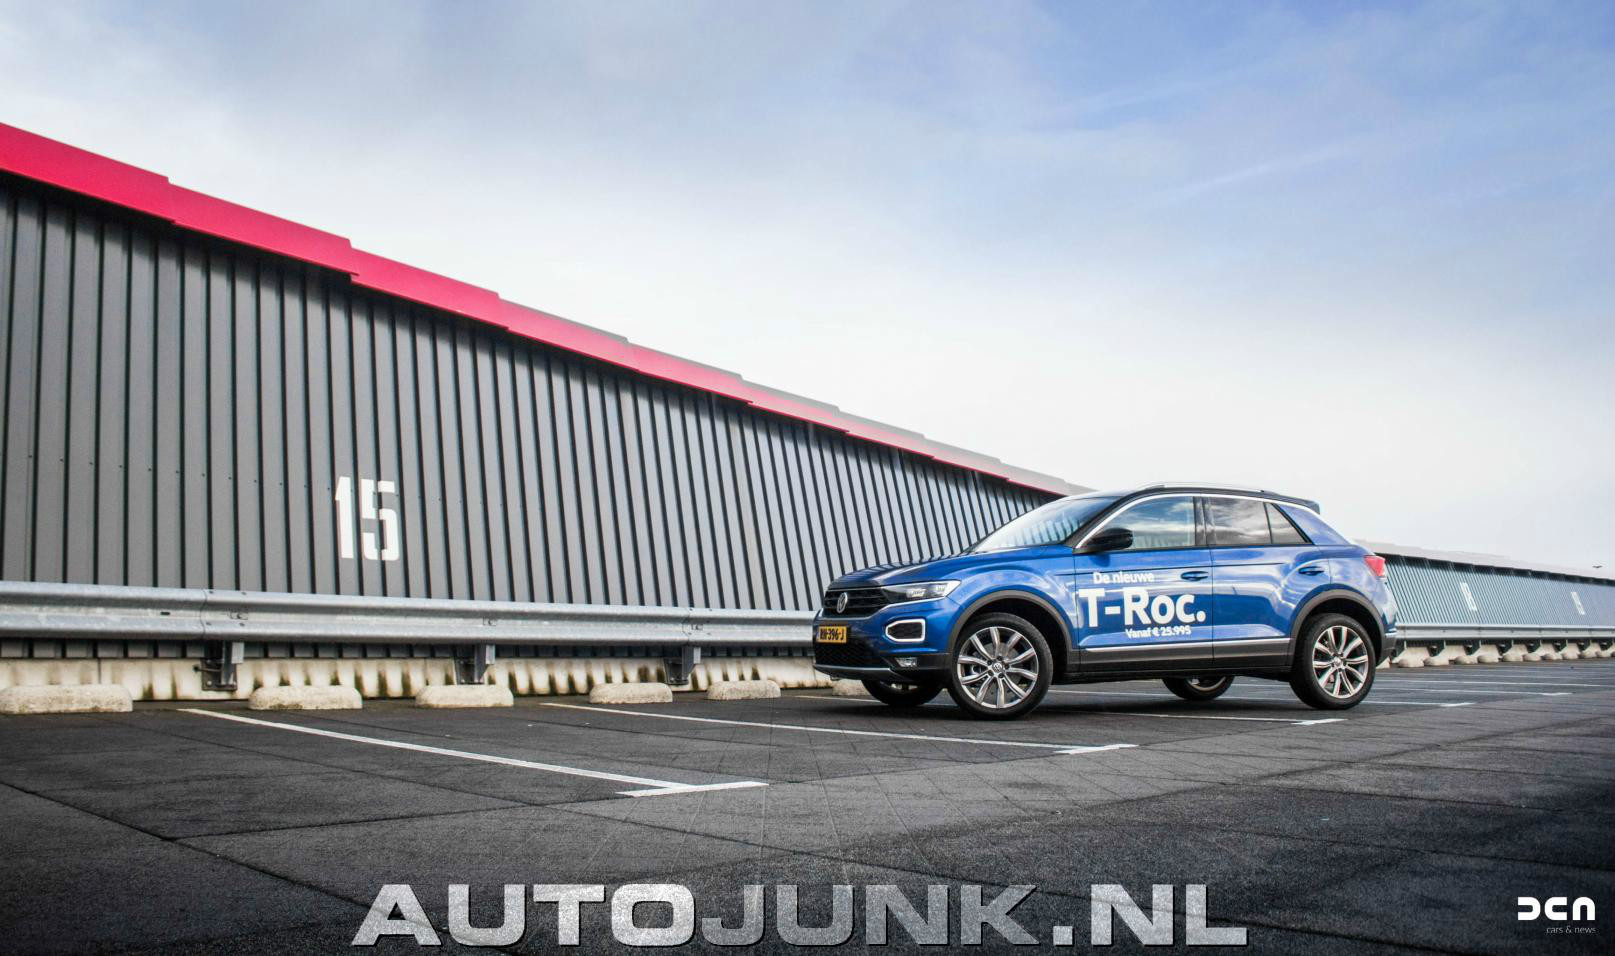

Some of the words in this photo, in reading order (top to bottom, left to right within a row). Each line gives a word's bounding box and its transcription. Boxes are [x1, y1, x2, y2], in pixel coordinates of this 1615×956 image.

[335, 476, 400, 561] 15
[1093, 572, 1110, 584] De
[1112, 571, 1155, 583] nieuwe
[1078, 587, 1206, 627] T-Roc.
[1125, 628, 1151, 639] Vanaf
